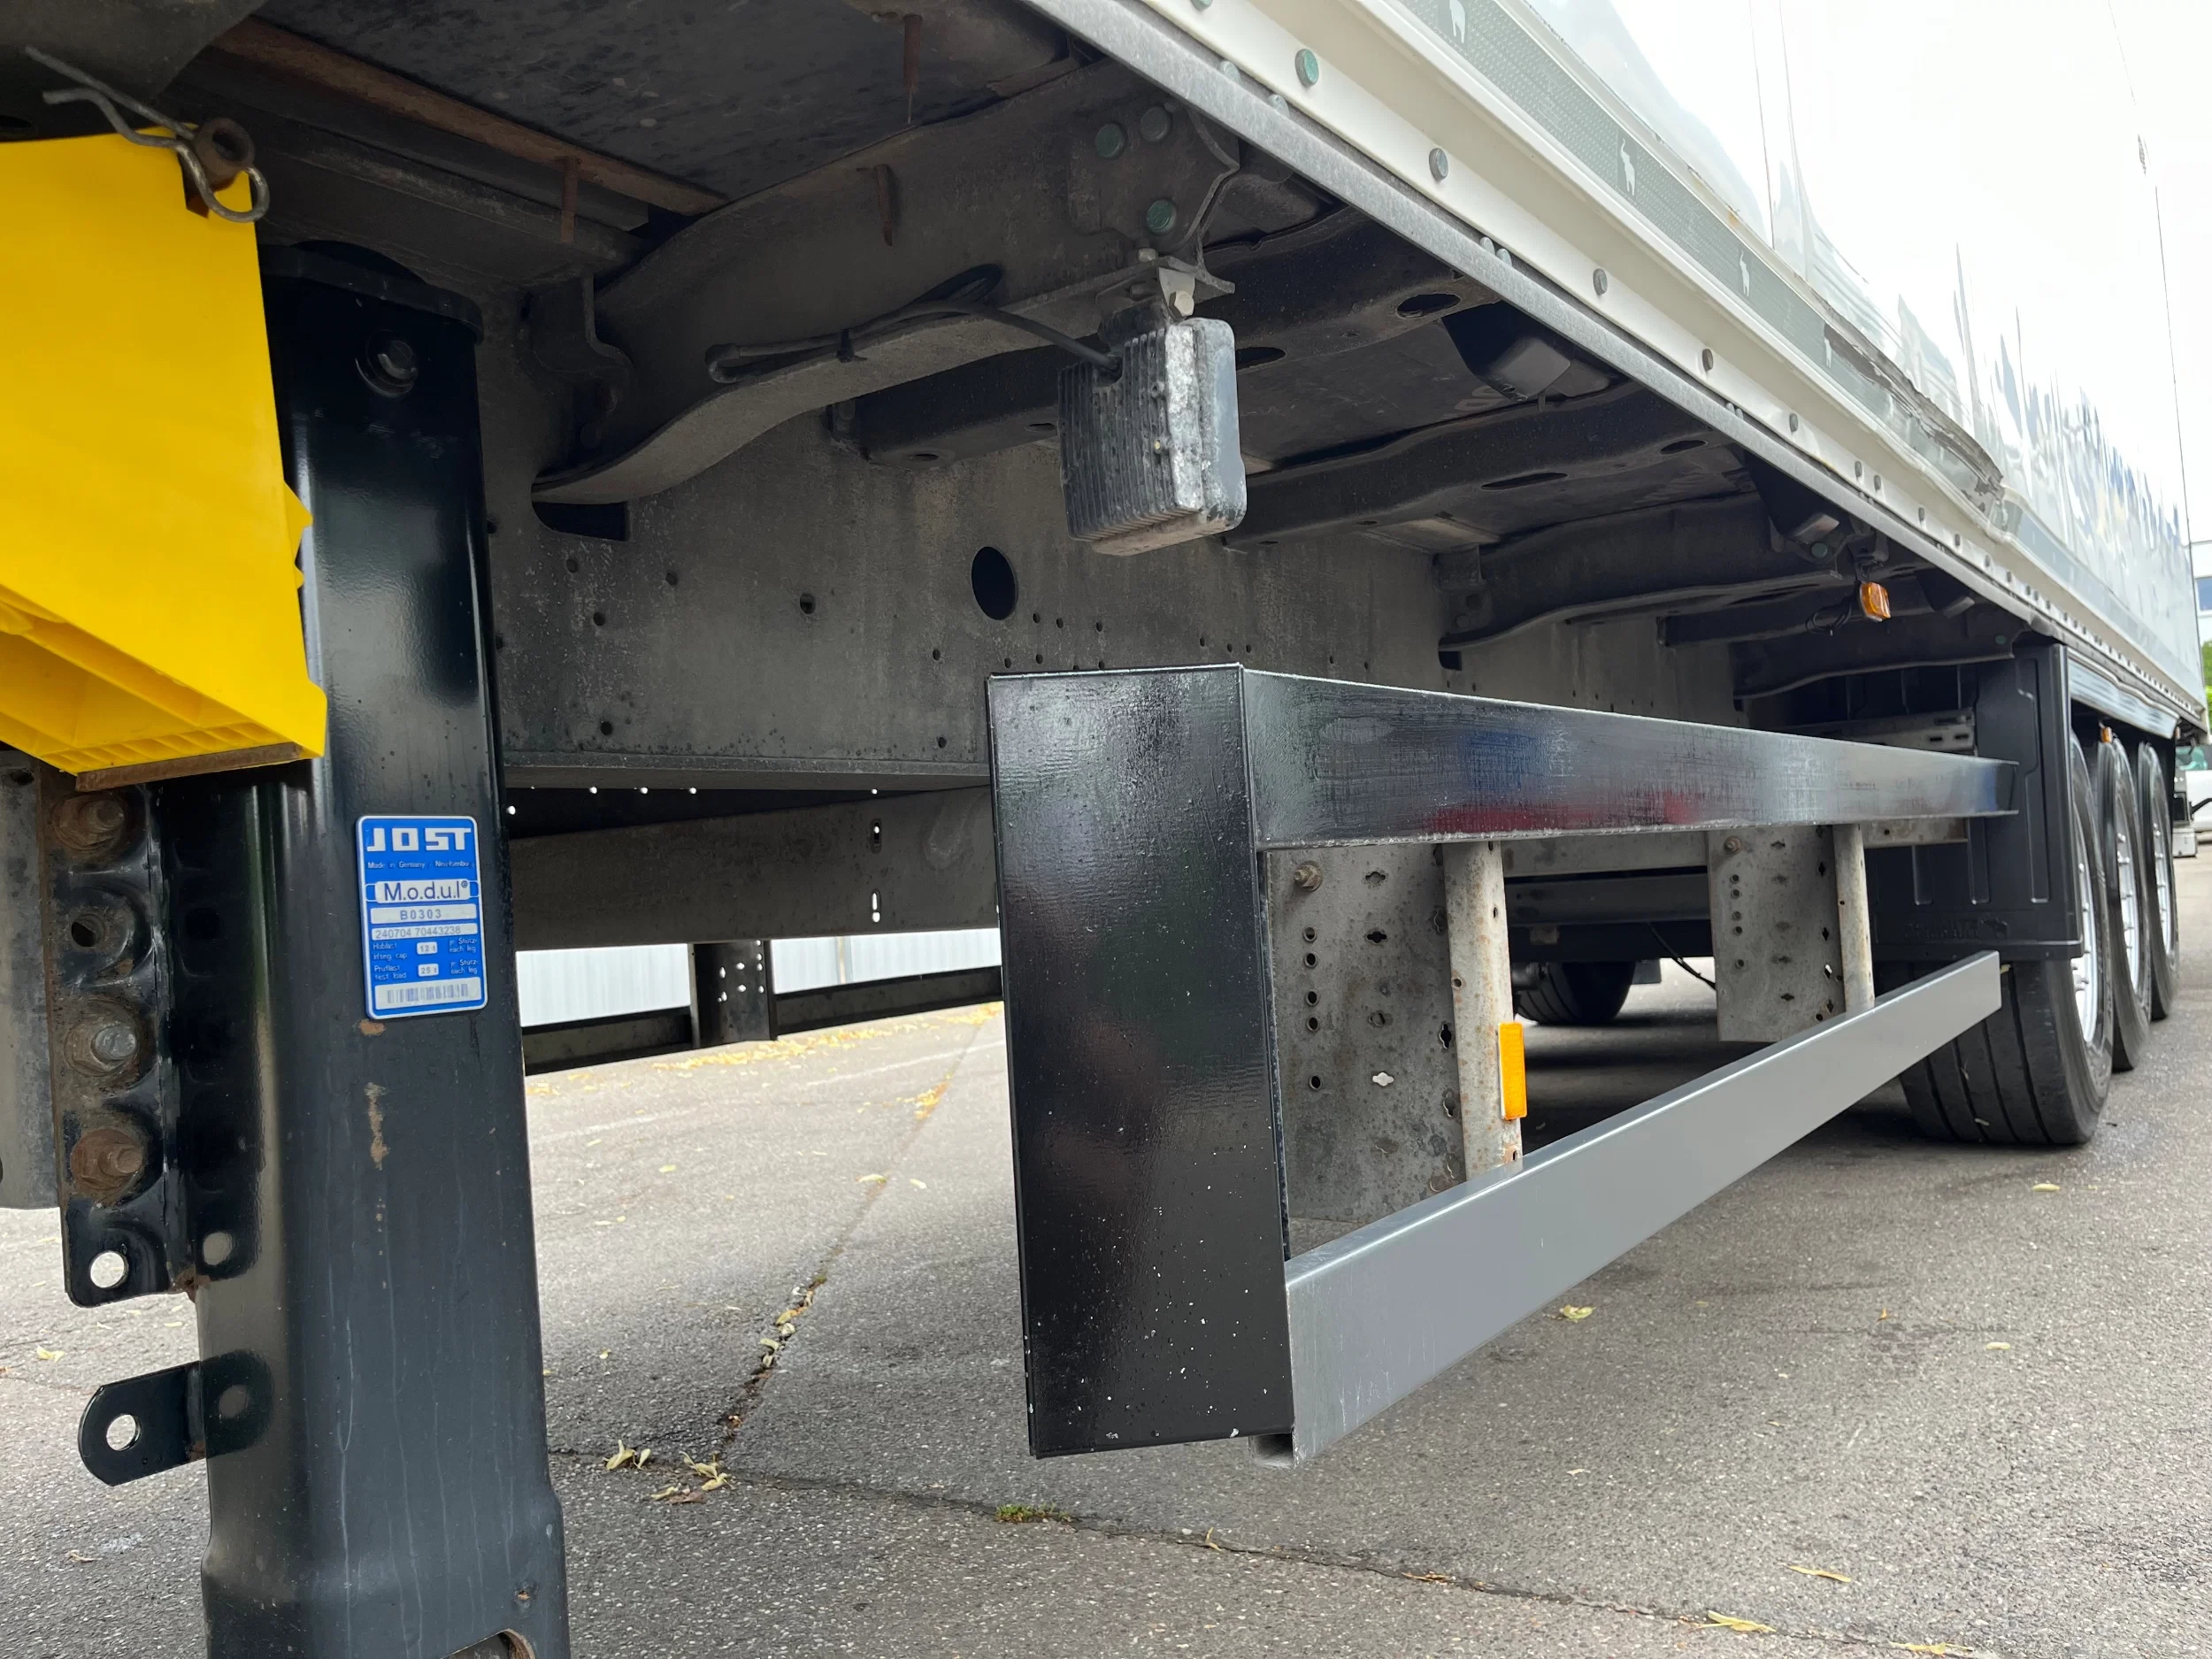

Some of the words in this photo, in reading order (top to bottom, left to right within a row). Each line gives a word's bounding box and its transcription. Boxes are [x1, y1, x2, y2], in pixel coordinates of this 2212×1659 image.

[366, 827, 472, 852] JOST
[398, 860, 426, 871] Germany
[399, 909, 442, 921] B0303
[374, 927, 412, 940] 240704
[414, 926, 462, 936] 70443238
[419, 944, 430, 953] 12
[466, 944, 477, 954] leg
[420, 966, 431, 975] 25
[467, 966, 478, 975] leg
